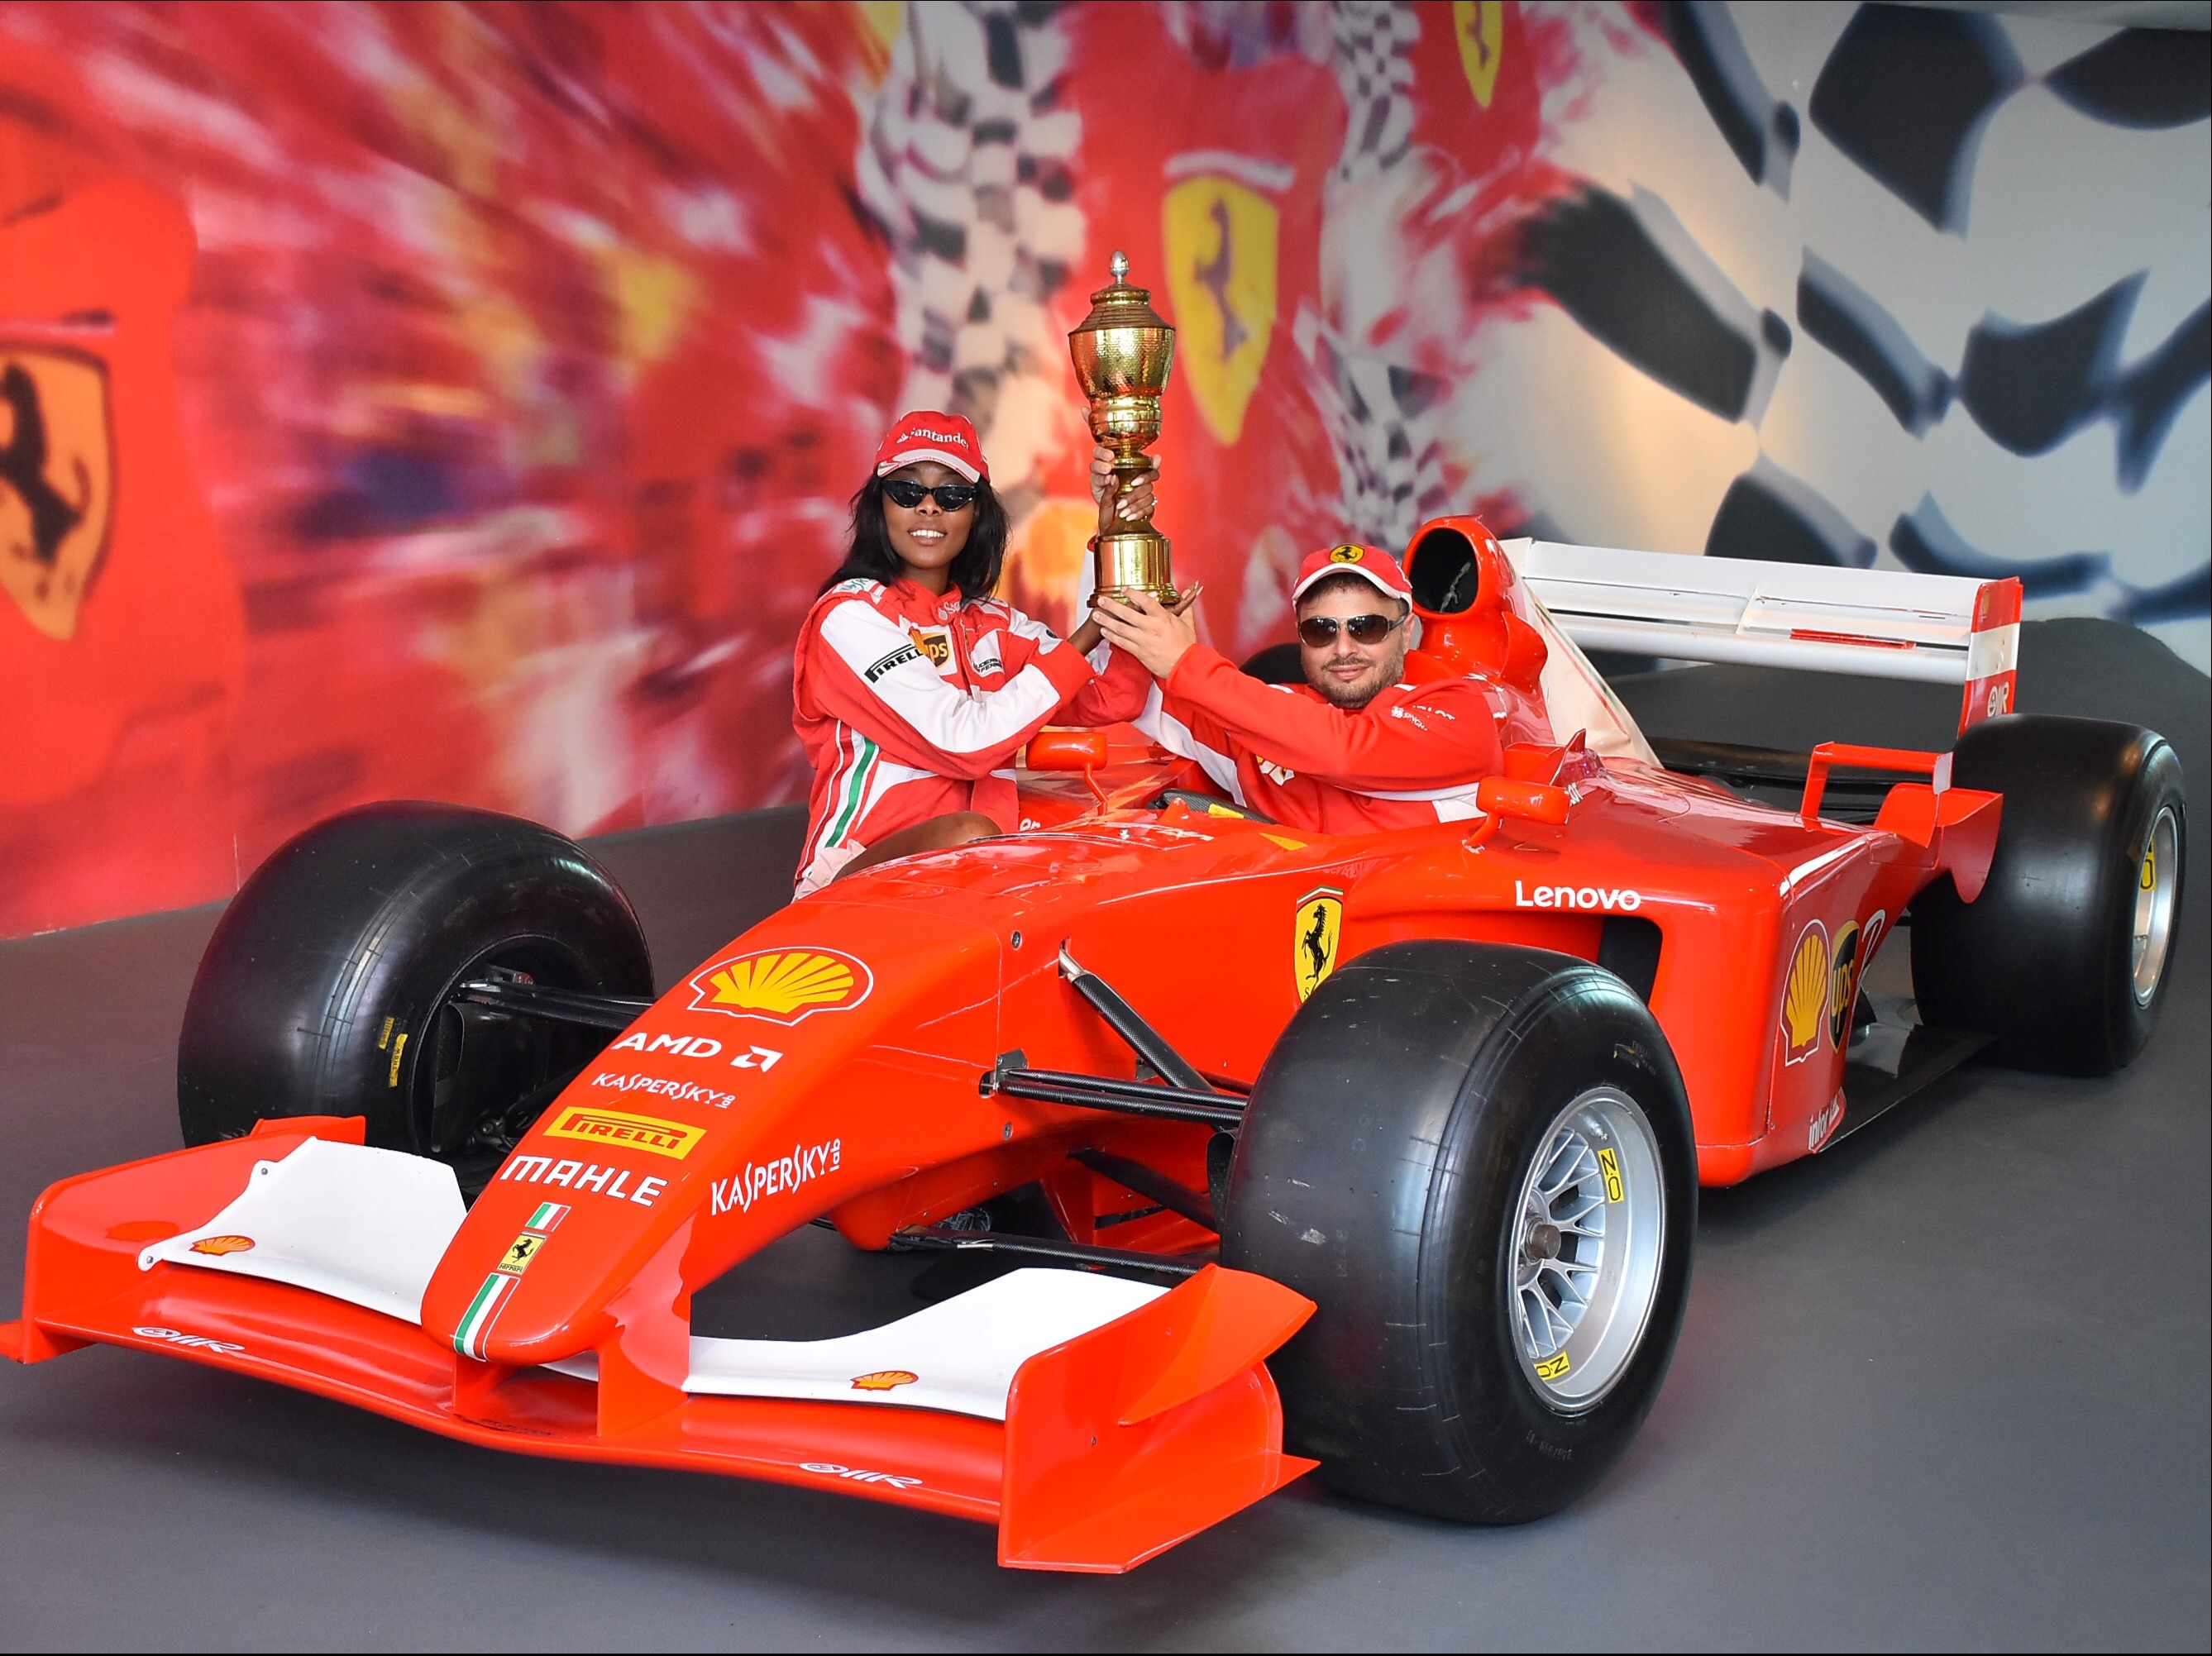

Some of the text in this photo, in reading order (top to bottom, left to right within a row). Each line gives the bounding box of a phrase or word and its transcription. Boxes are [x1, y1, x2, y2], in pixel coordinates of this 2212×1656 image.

[864, 643, 924, 684] PIRELL
[1515, 880, 1641, 911] Lenovo
[610, 1032, 722, 1058] AMD
[591, 1072, 736, 1109] KASPERSKY lab
[560, 1113, 688, 1150] PIRELLI
[499, 1155, 669, 1207] MAHLE
[711, 1138, 841, 1216] KASPERSKY lab
